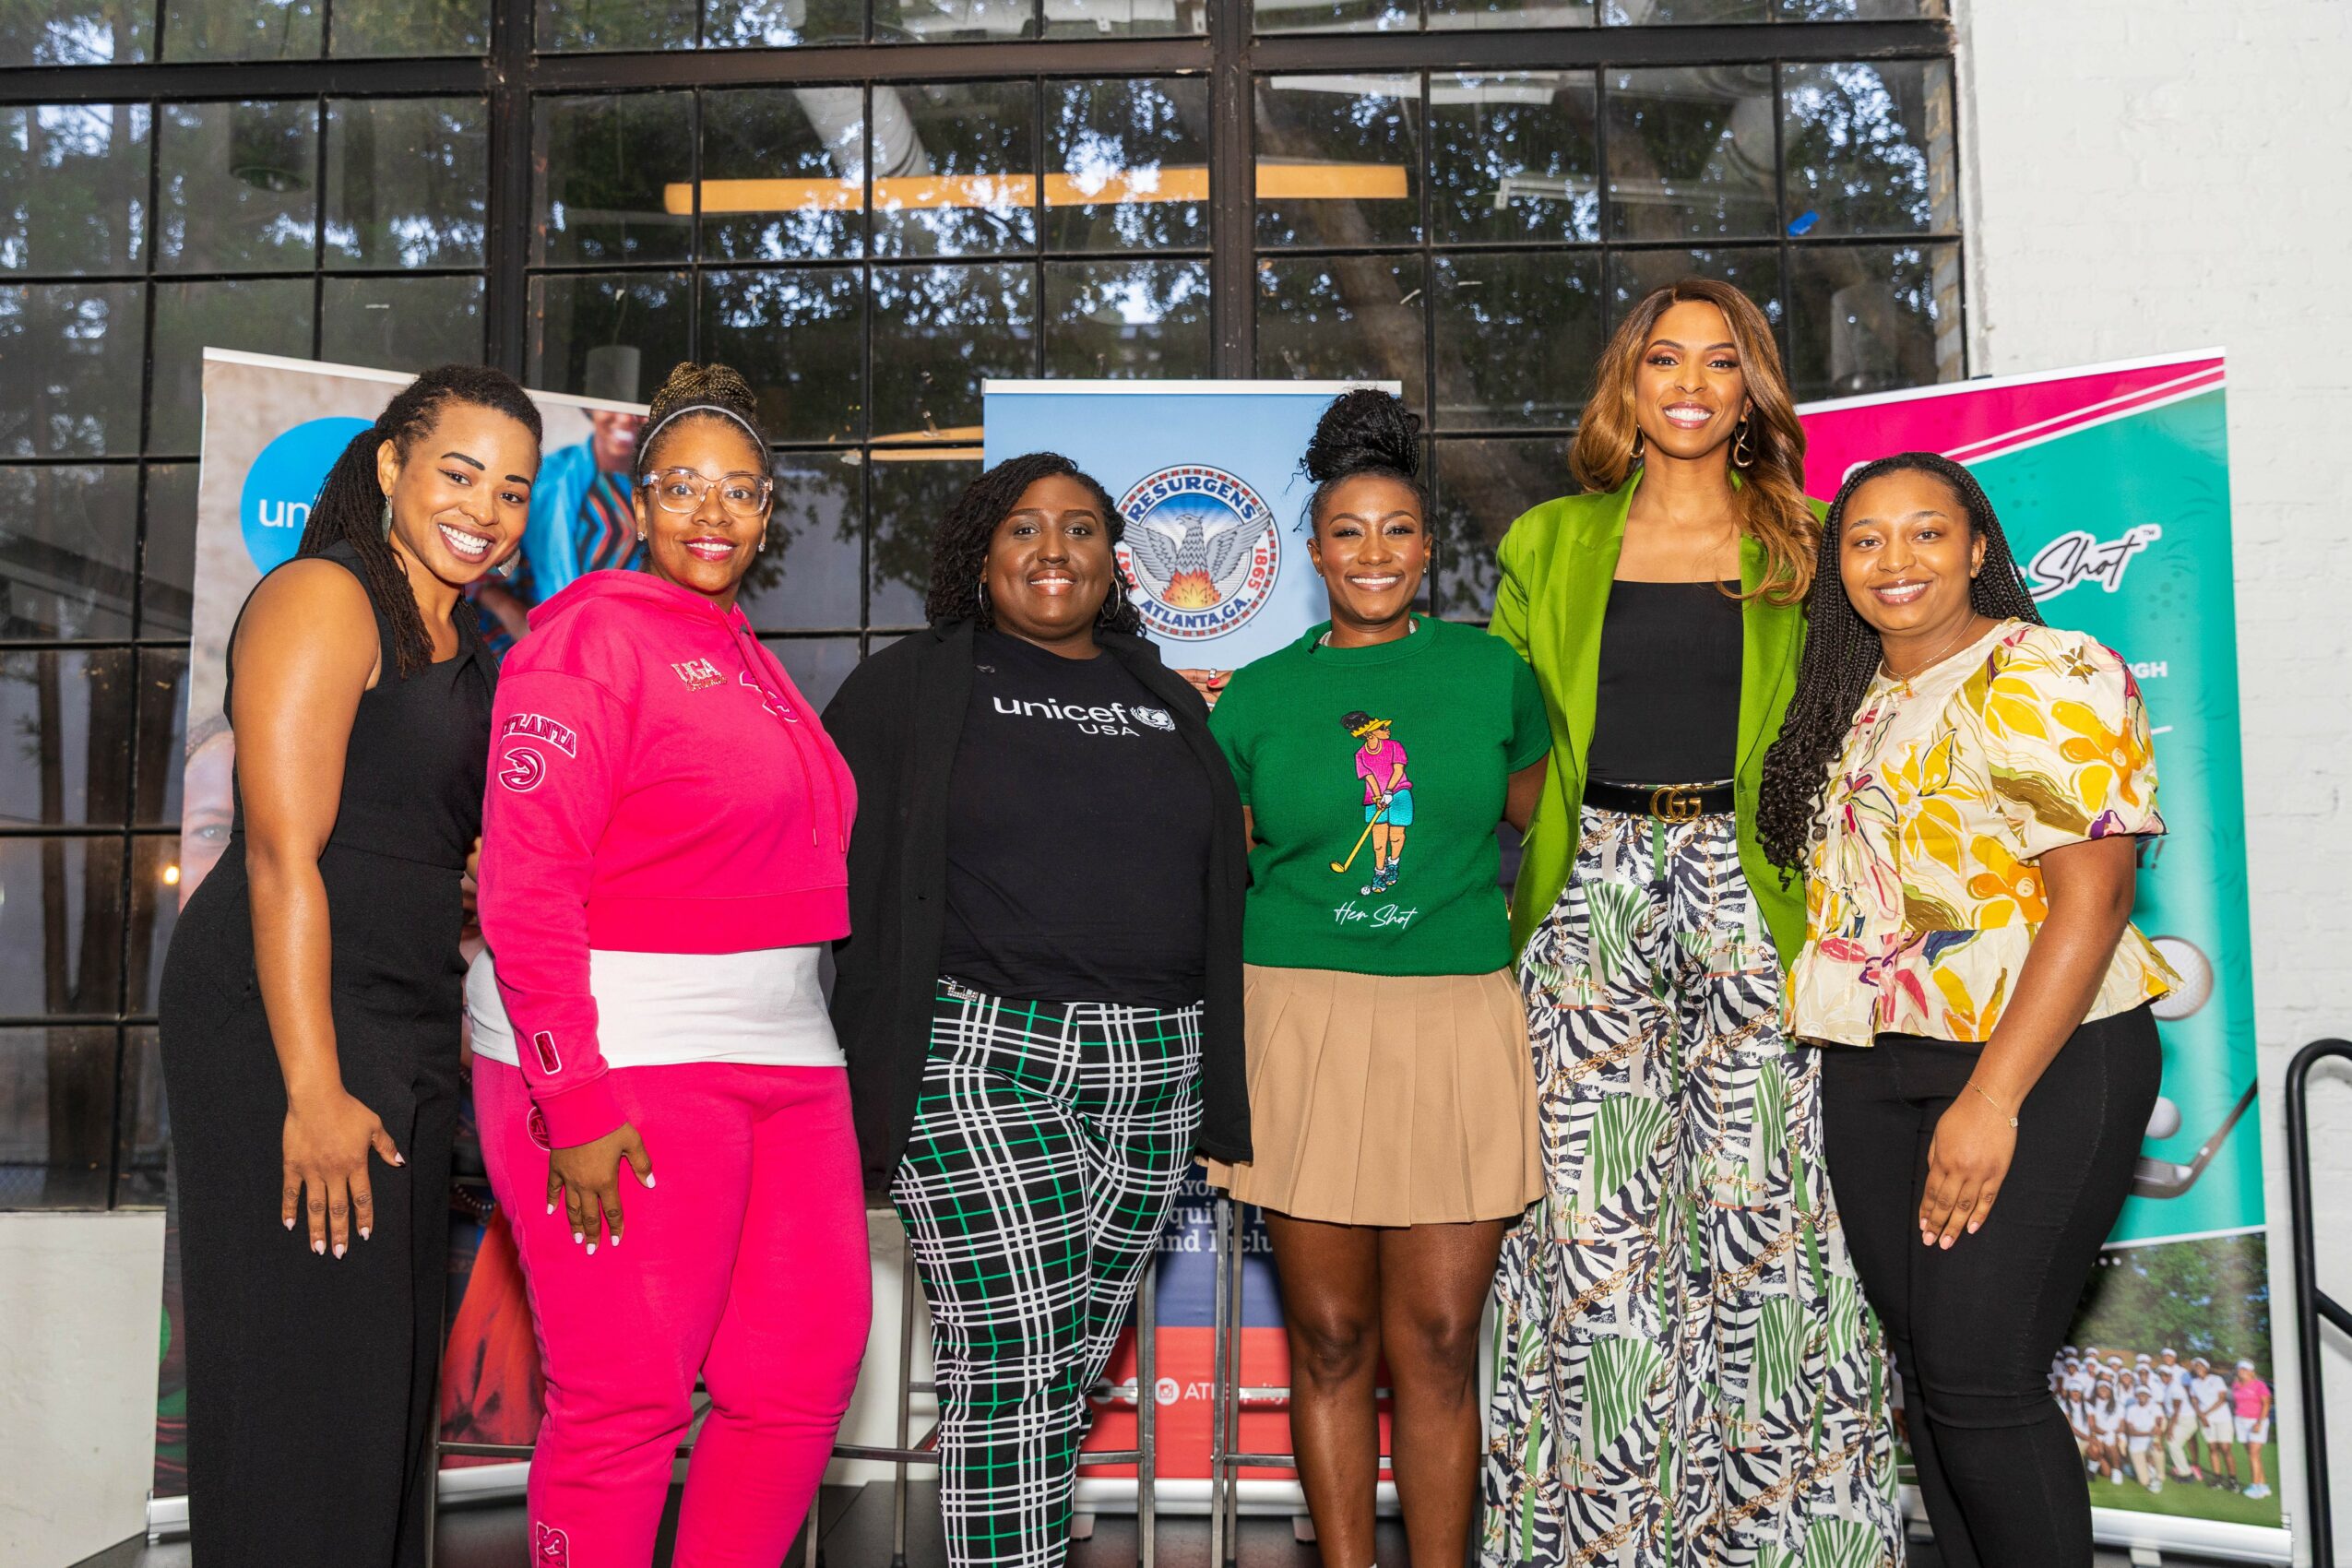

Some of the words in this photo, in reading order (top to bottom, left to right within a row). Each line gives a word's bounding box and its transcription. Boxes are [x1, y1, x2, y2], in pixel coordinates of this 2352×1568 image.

[258, 494, 317, 529] un
[1127, 476, 1256, 522] RESURGENS
[1247, 548, 1268, 591] 1865
[2031, 533, 2141, 598] Shot
[992, 696, 1129, 725] unicef
[501, 712, 576, 758] TLANTA
[1077, 723, 1141, 738] USA
[1334, 900, 1369, 925] Her
[1370, 904, 1418, 930] Shot
[1155, 1229, 1202, 1253] and
